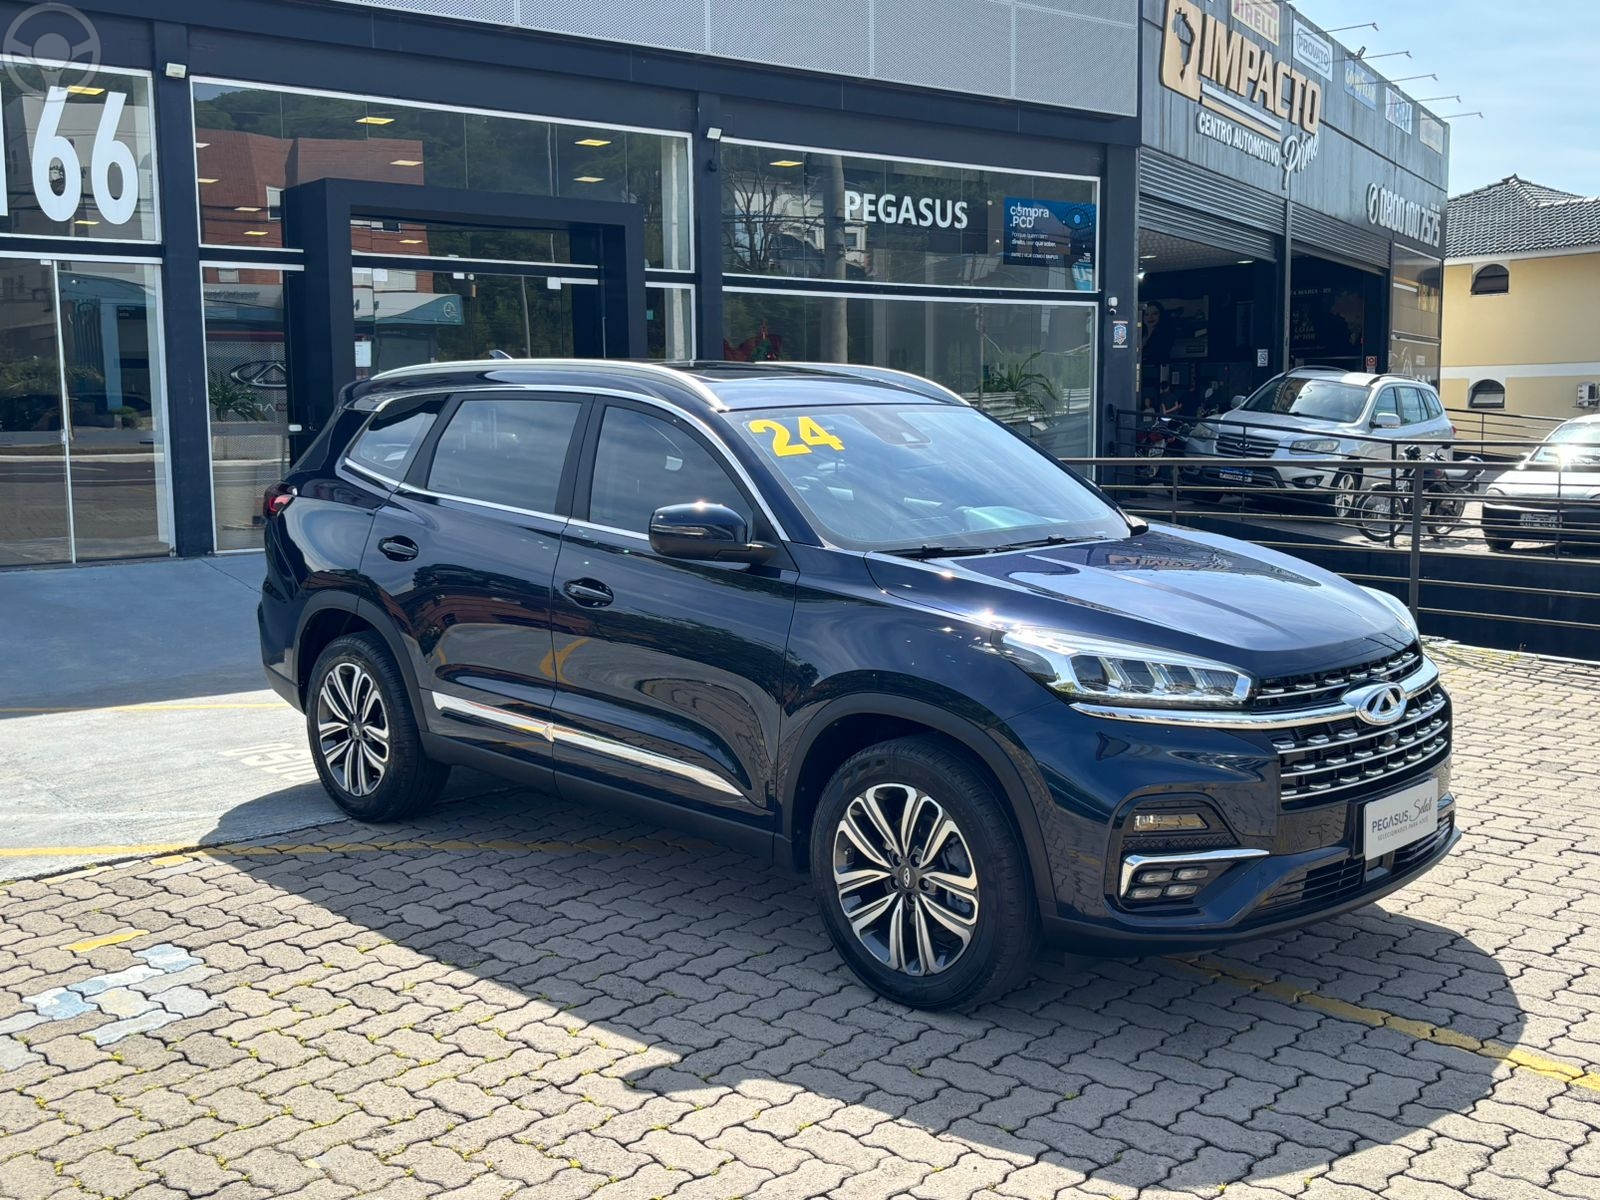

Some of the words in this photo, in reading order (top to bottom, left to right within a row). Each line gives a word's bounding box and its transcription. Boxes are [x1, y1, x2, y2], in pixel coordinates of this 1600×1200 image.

[1202, 15, 1321, 134] IMPACTO
[1199, 111, 1233, 147] CENTRO
[1233, 127, 1280, 167] AUTOMOTIVO
[1282, 130, 1320, 190] Prime
[844, 190, 968, 229] PEGASUS
[1010, 202, 1049, 219] compra
[1380, 187, 1405, 234] 0800
[1405, 201, 1421, 239] 100
[1420, 206, 1441, 248] 7575
[748, 416, 845, 457] 24
[1371, 810, 1409, 833] PEGASUS
